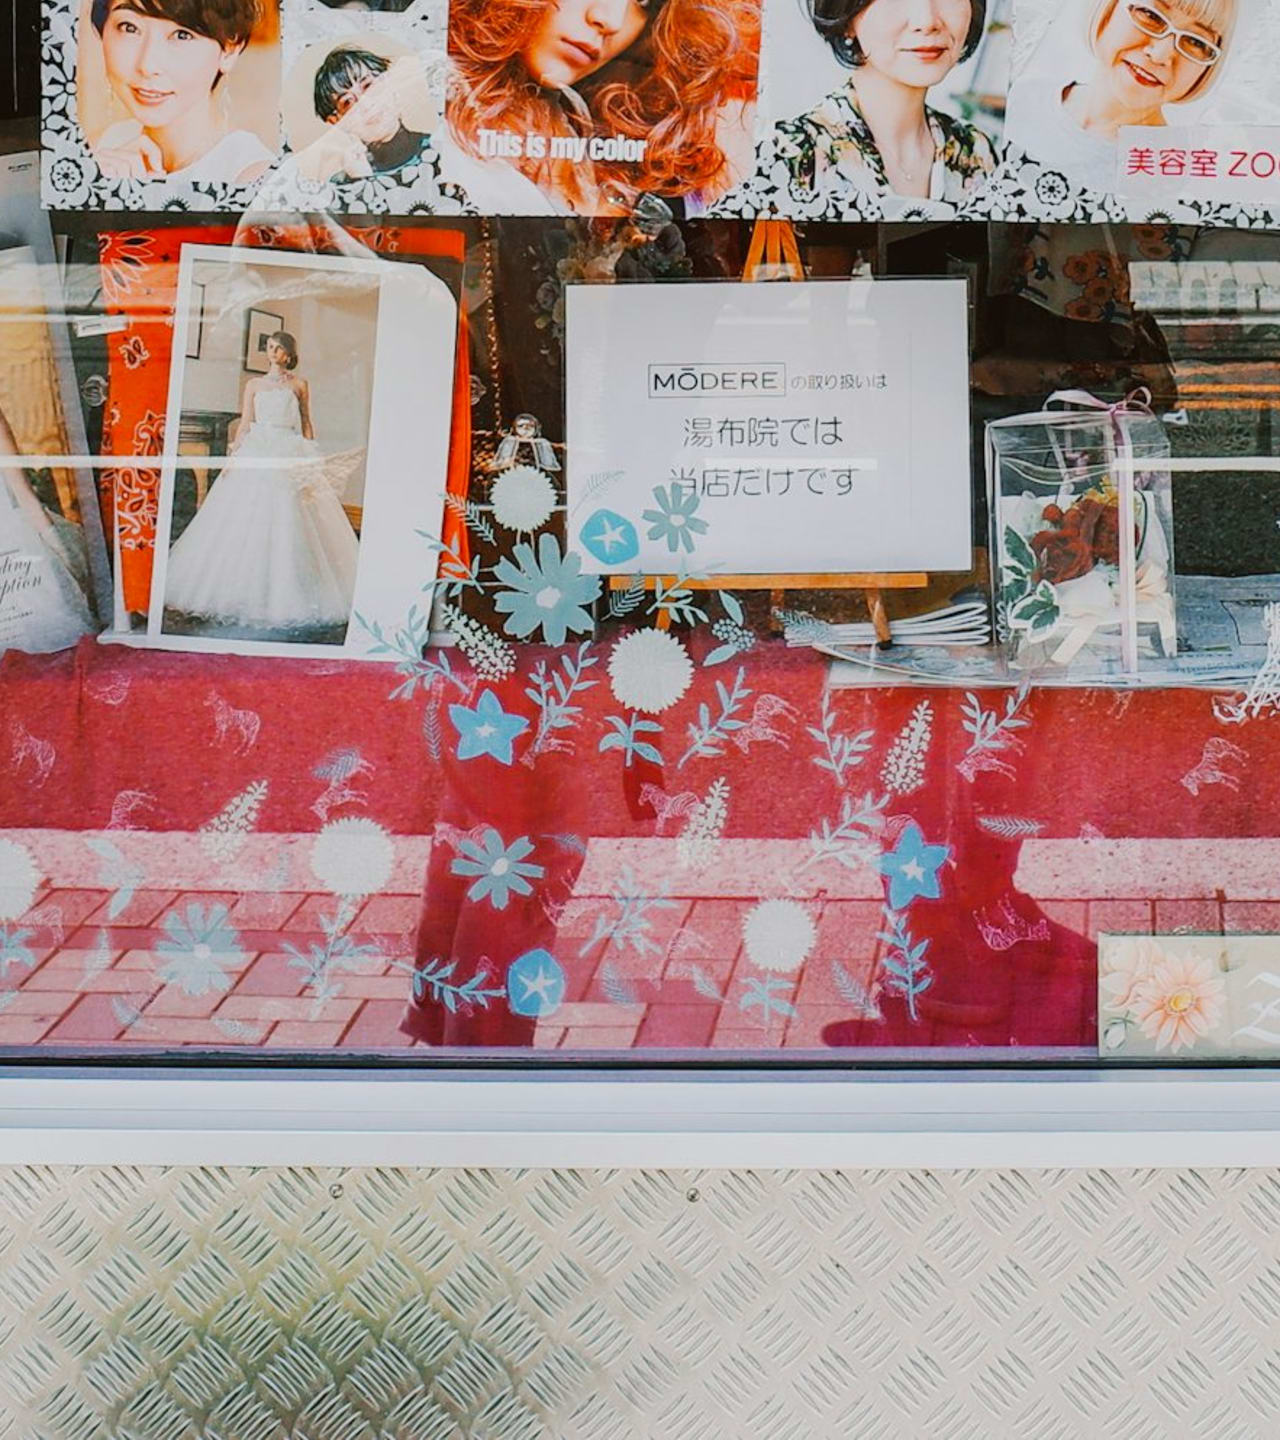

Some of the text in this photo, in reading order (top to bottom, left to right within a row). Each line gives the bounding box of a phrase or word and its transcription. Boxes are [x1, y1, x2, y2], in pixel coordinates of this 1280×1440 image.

[478, 129, 648, 163] This is my color
[1126, 148, 1219, 179] 美容室
[791, 372, 889, 391] の取り扱いは
[683, 417, 844, 449] 湯布院では
[669, 466, 860, 498] 当店だけです
